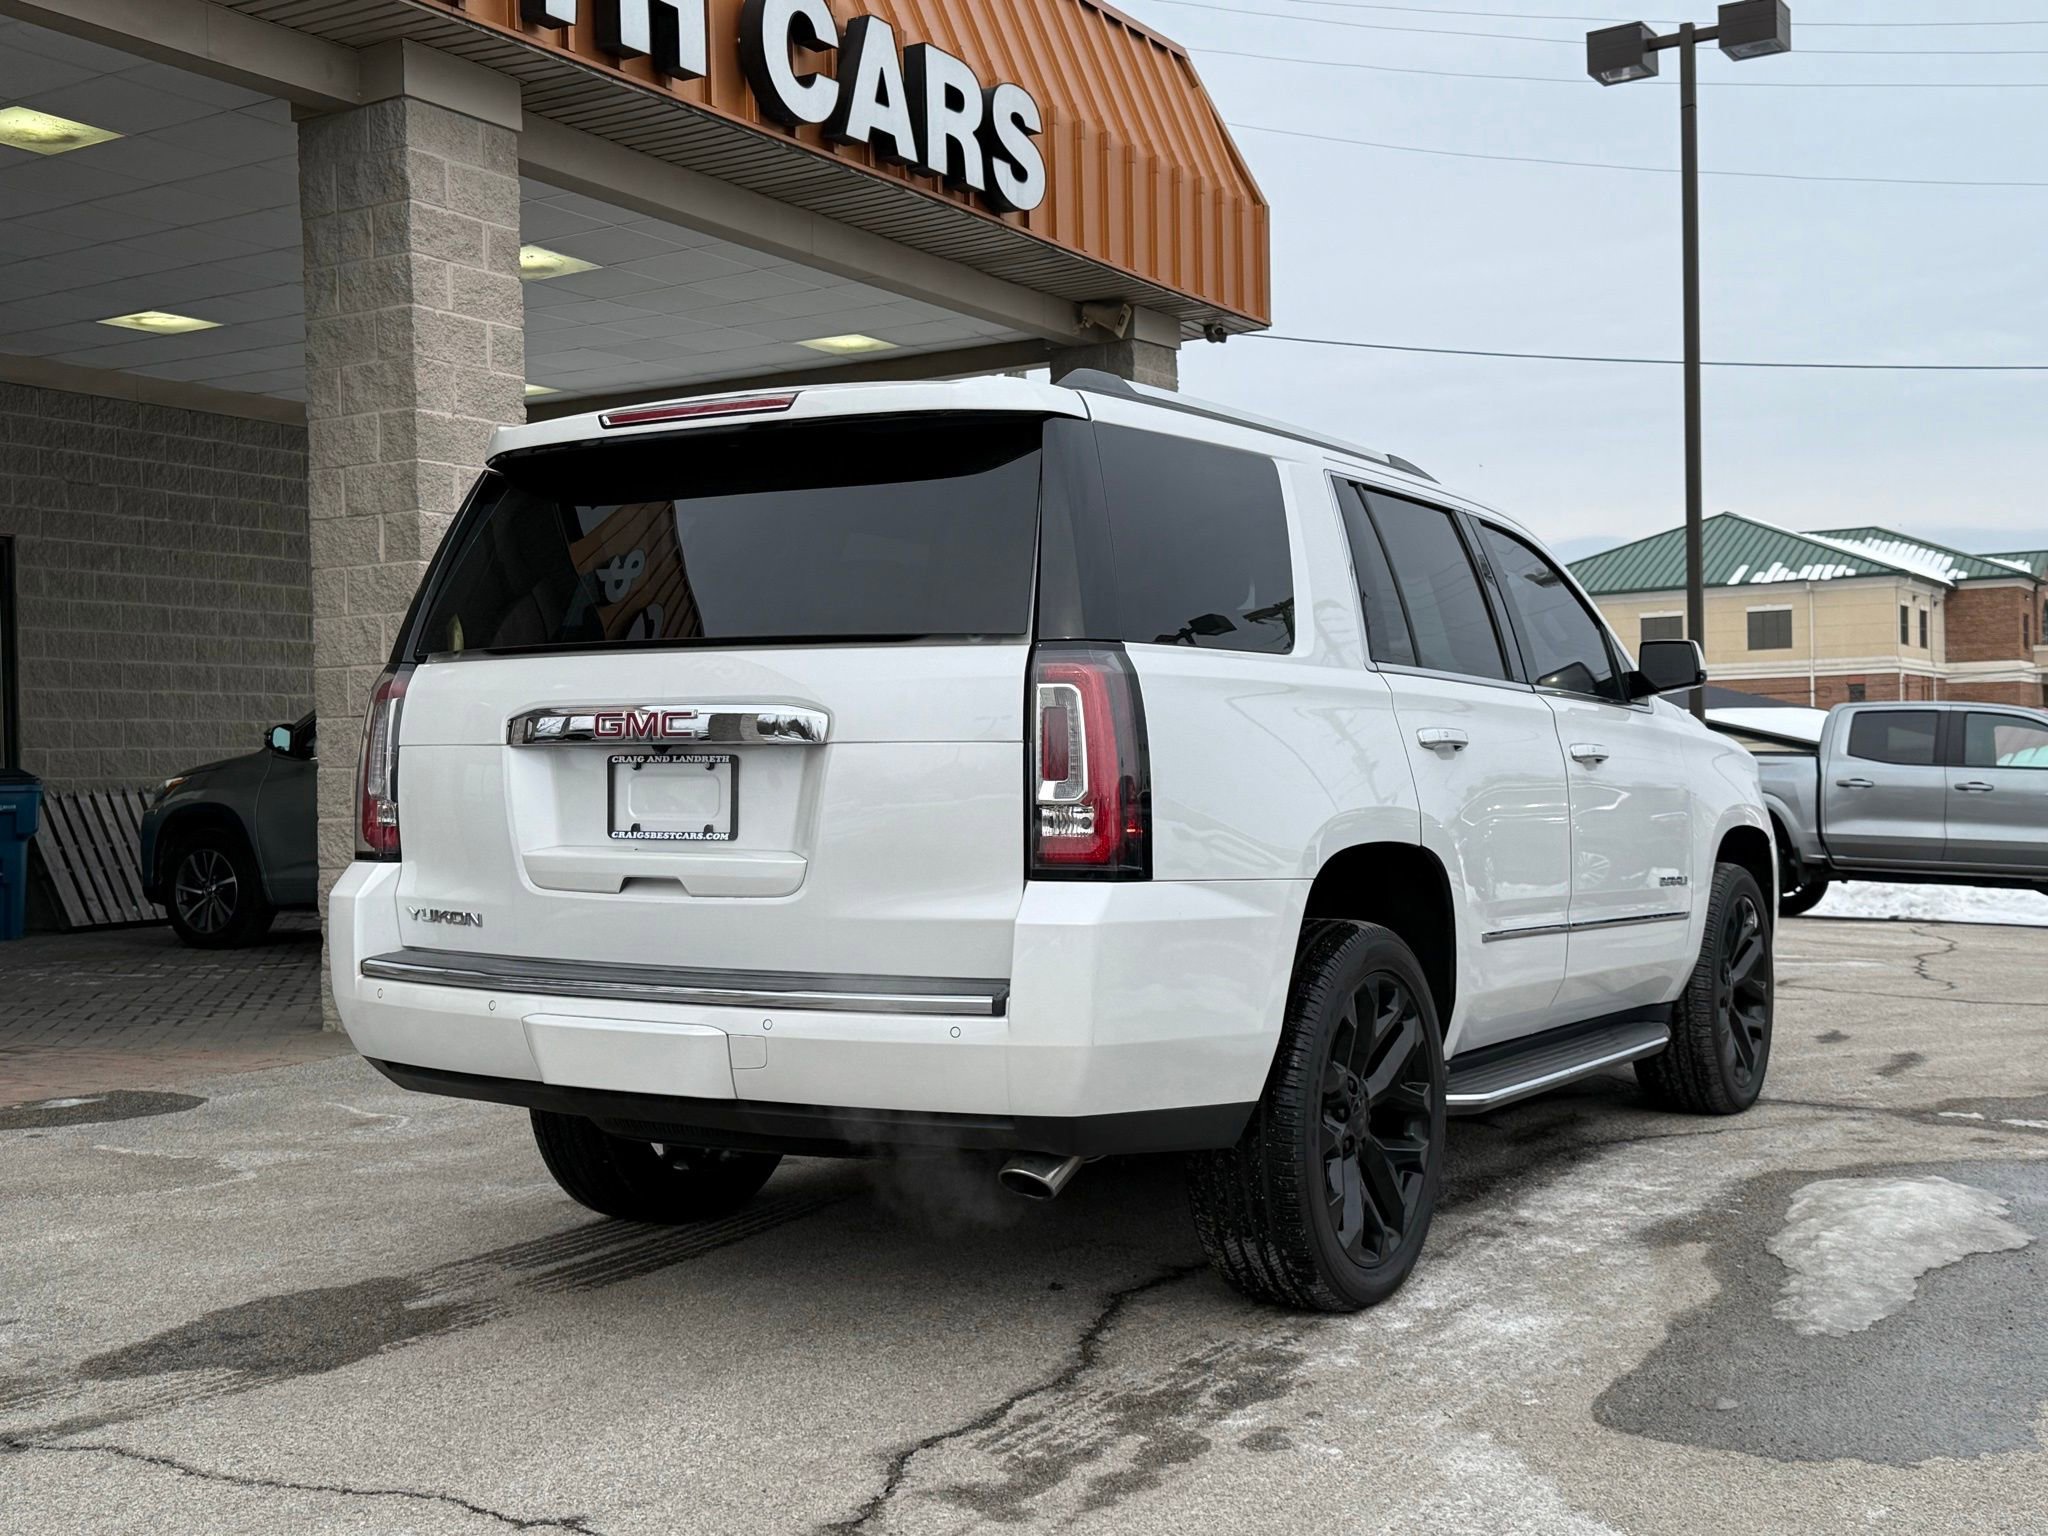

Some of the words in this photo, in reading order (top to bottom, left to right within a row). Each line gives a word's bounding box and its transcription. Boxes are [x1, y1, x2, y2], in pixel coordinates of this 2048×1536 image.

[758, 0, 1047, 211] CARS
[593, 708, 699, 740] GMC
[611, 755, 645, 763] CRAIG
[647, 755, 670, 763] AND
[672, 755, 730, 763] LANDRETH
[611, 831, 729, 841] CRAIGSBESTCARS.COM
[408, 905, 483, 928] YUKON
